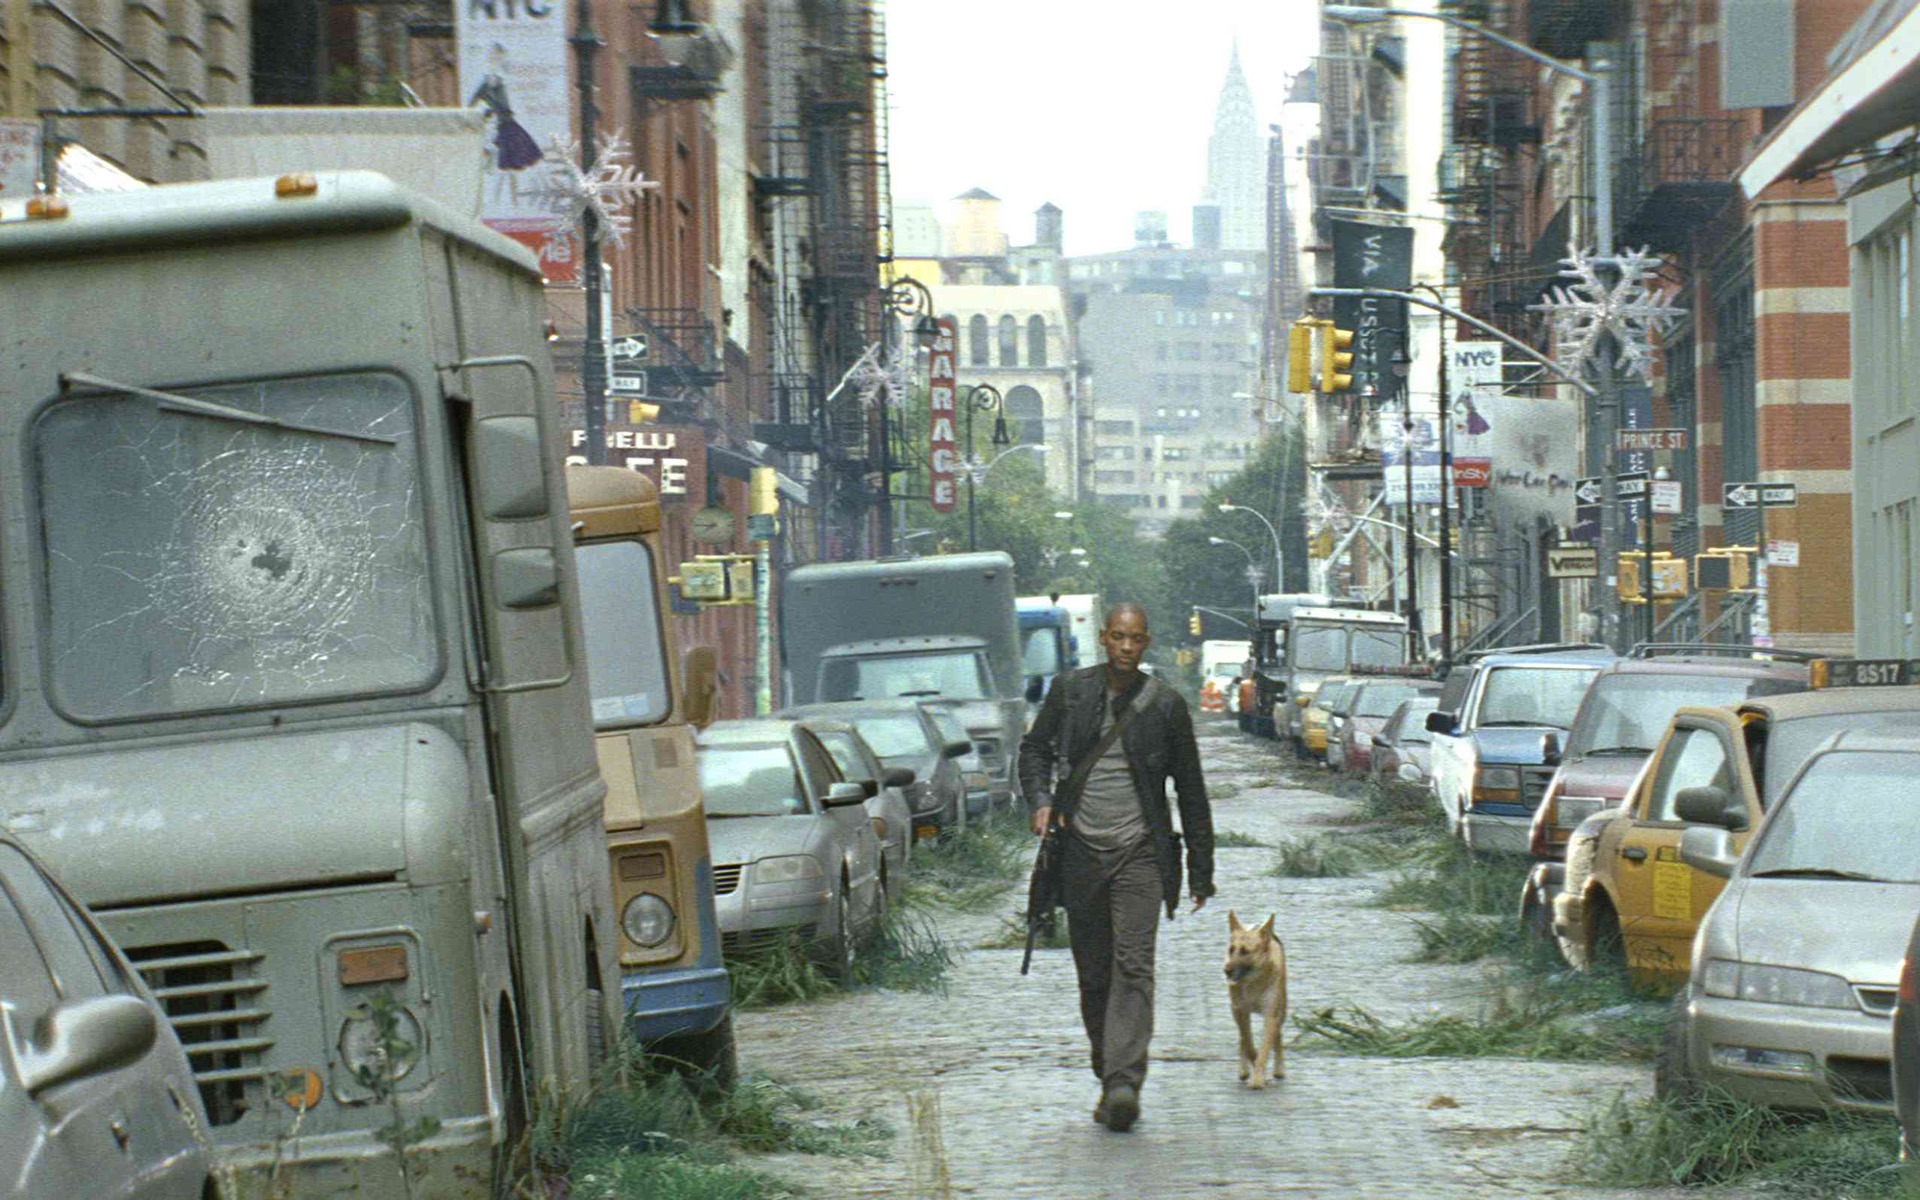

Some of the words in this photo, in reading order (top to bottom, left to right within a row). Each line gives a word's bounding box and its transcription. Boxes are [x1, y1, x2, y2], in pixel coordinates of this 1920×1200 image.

[1456, 348, 1496, 367] NYC
[932, 326, 955, 504] GARAGE
[1622, 432, 1663, 449] PRINCE
[1667, 431, 1683, 449] ST
